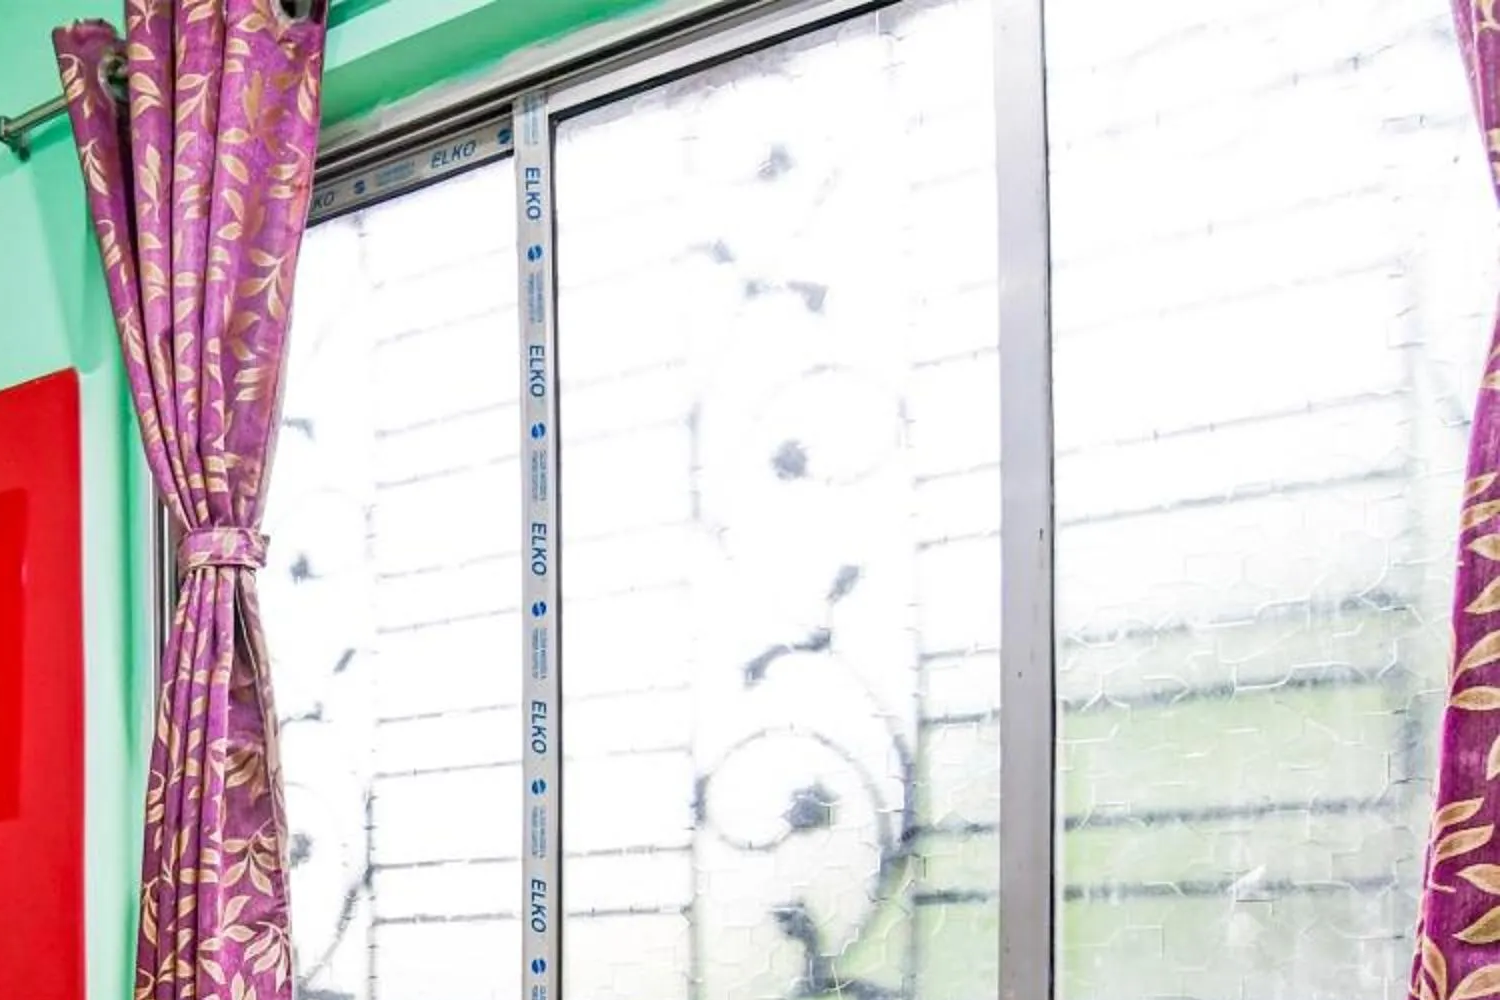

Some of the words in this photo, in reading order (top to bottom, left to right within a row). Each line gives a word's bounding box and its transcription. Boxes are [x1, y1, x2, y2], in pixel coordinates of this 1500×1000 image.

[430, 140, 477, 168] ELKO
[525, 167, 541, 220] ELKO
[529, 345, 545, 398] ELKO
[531, 523, 547, 576] ELKO
[531, 699, 547, 754] ELKO
[531, 879, 547, 933] ELKO
